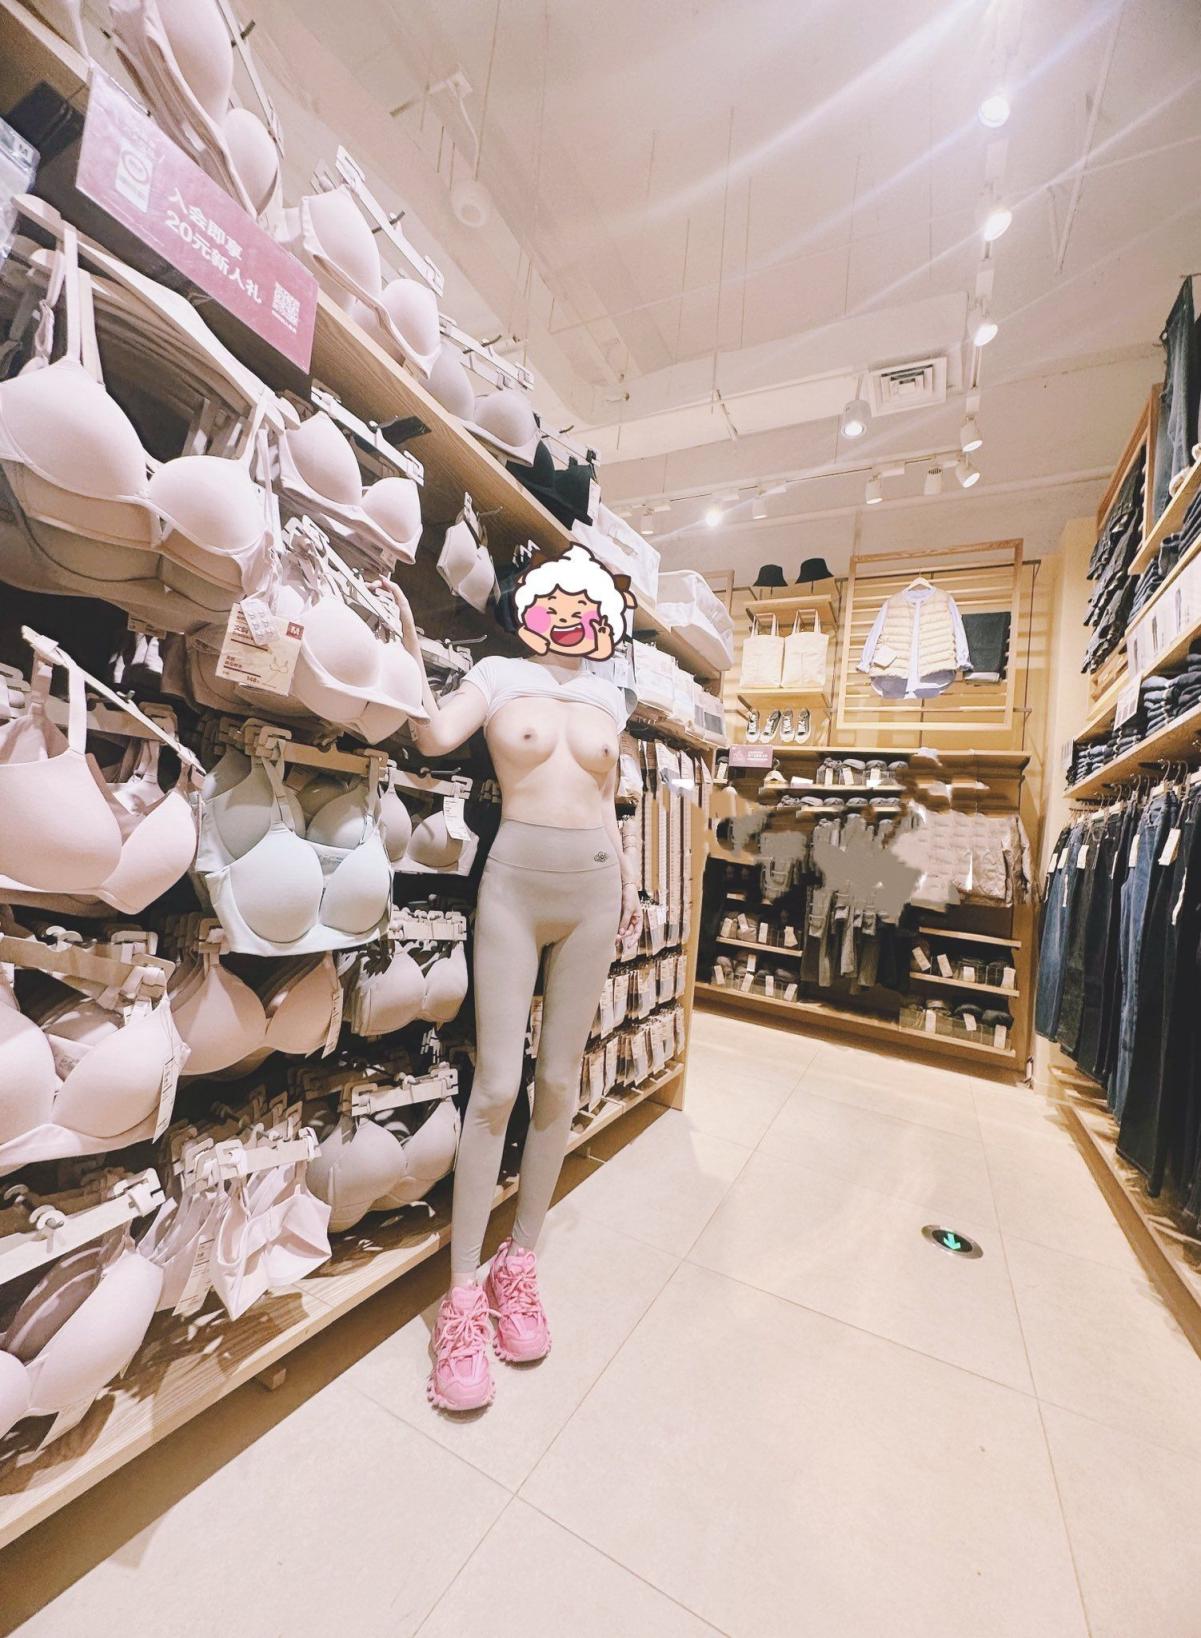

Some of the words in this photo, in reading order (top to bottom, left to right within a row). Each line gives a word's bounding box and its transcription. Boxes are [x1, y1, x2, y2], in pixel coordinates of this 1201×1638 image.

[165, 210, 263, 304] 20元新人礼
[167, 187, 243, 260] 入会即享
